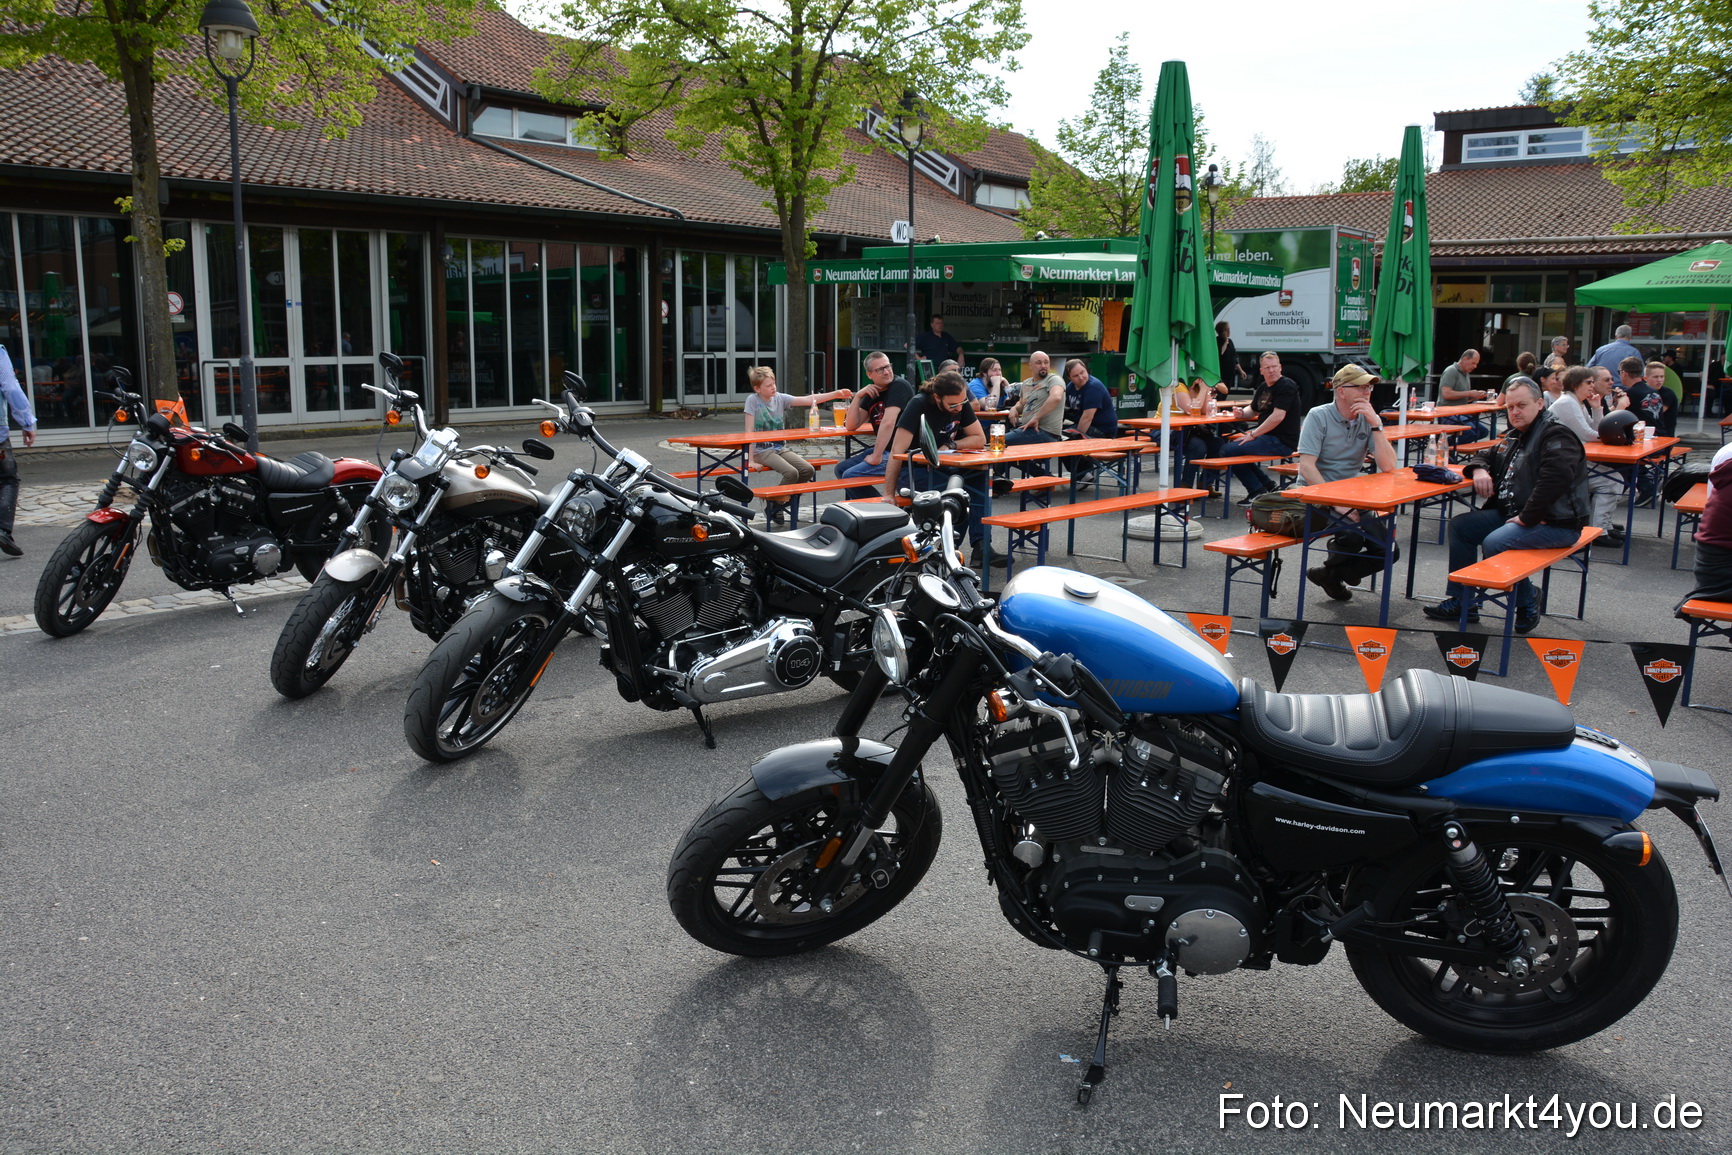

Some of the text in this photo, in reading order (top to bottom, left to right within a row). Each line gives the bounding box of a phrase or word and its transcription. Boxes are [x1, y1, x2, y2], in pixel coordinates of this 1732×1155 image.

[896, 222, 907, 240] WC
[1234, 249, 1274, 262] leben.
[825, 267, 880, 281] Neumarkter
[1039, 266, 1113, 281] Neumarkter
[1212, 269, 1282, 288] Neumarkter Lammsbräu
[1645, 278, 1732, 286] Lammsbrä
[948, 291, 988, 303] Neumarkter
[941, 301, 994, 317] Lammsbräu
[1260, 316, 1311, 326] Lammsbräu
[790, 657, 811, 669] 114
[1274, 816, 1366, 835] www.harley-davidson.com
